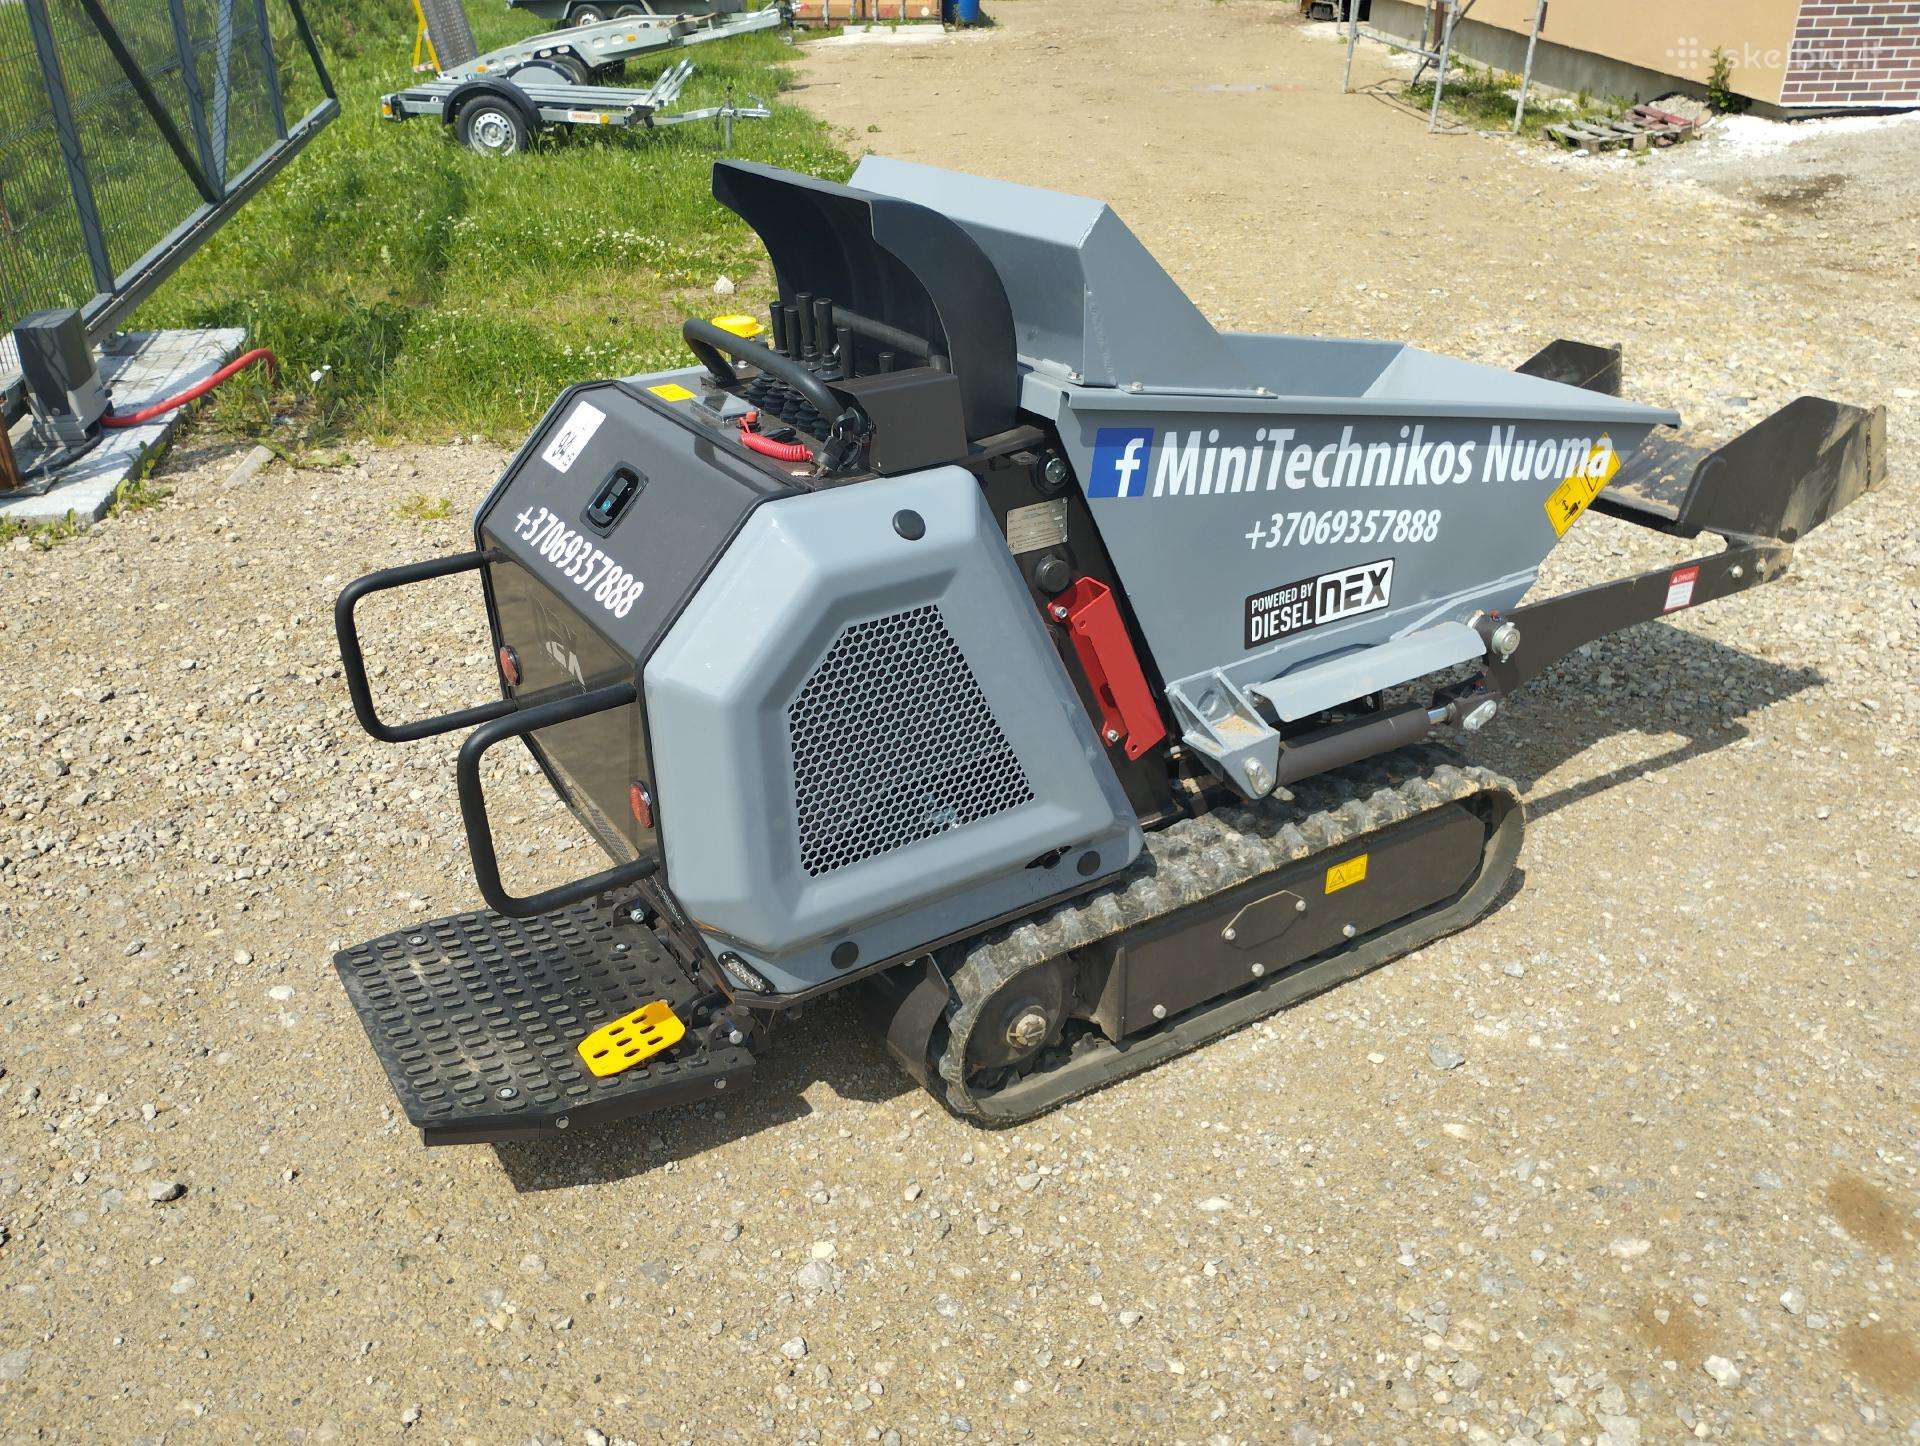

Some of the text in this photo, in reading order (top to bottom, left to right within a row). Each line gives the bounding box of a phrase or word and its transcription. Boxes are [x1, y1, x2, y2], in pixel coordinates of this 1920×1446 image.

[1152, 425, 1477, 498] MiniTechnikos
[1481, 424, 1613, 483] Nuoma
[1244, 509, 1442, 550] +37069357888
[514, 506, 645, 619] +37069357888
[1251, 582, 1314, 615] POWERED BY
[1251, 600, 1313, 643] DIESEL
